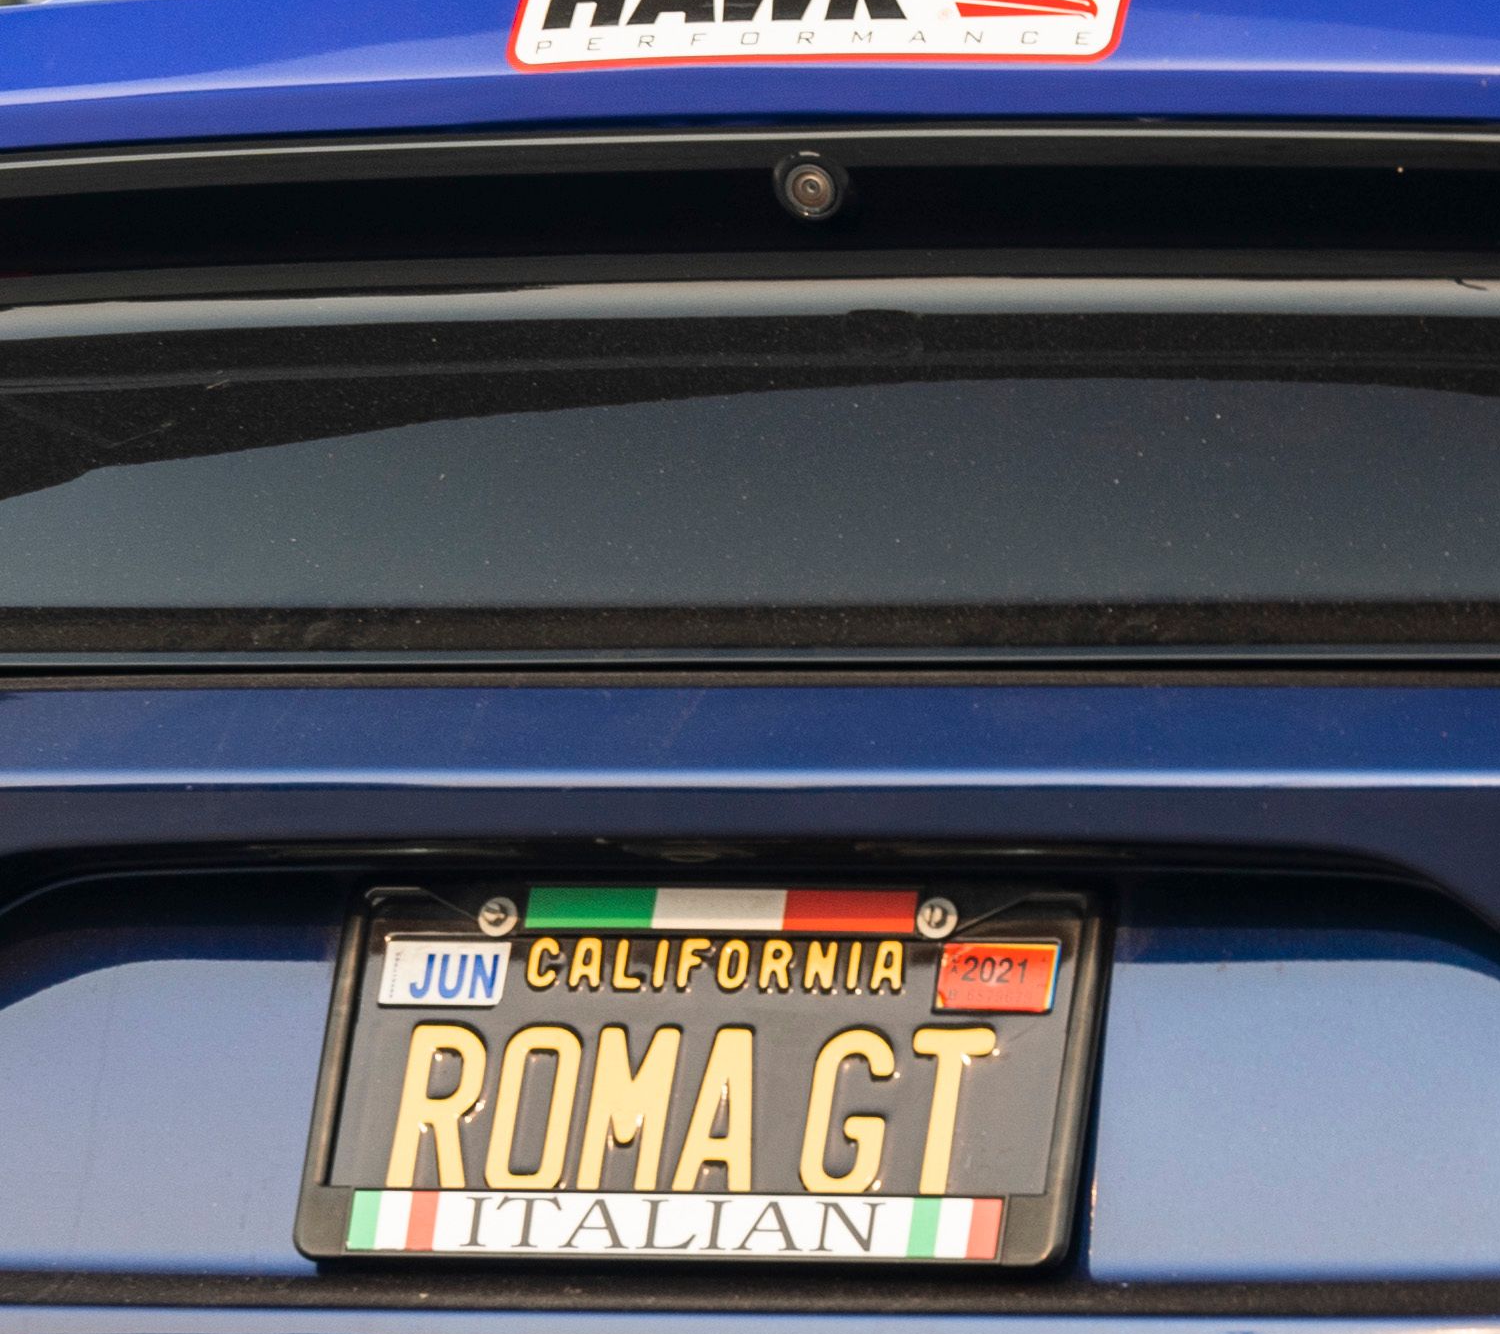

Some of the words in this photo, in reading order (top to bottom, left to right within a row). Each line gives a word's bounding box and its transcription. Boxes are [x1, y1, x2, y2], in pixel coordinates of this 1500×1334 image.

[535, 29, 1094, 55] PERFORMANCE
[409, 953, 500, 1000] JUN
[525, 936, 906, 995] CALIFORNIA
[961, 955, 1029, 985] 2021
[386, 1024, 755, 1193] ROMA
[799, 1026, 997, 1195] GT
[460, 1195, 887, 1255] ITALIAN
